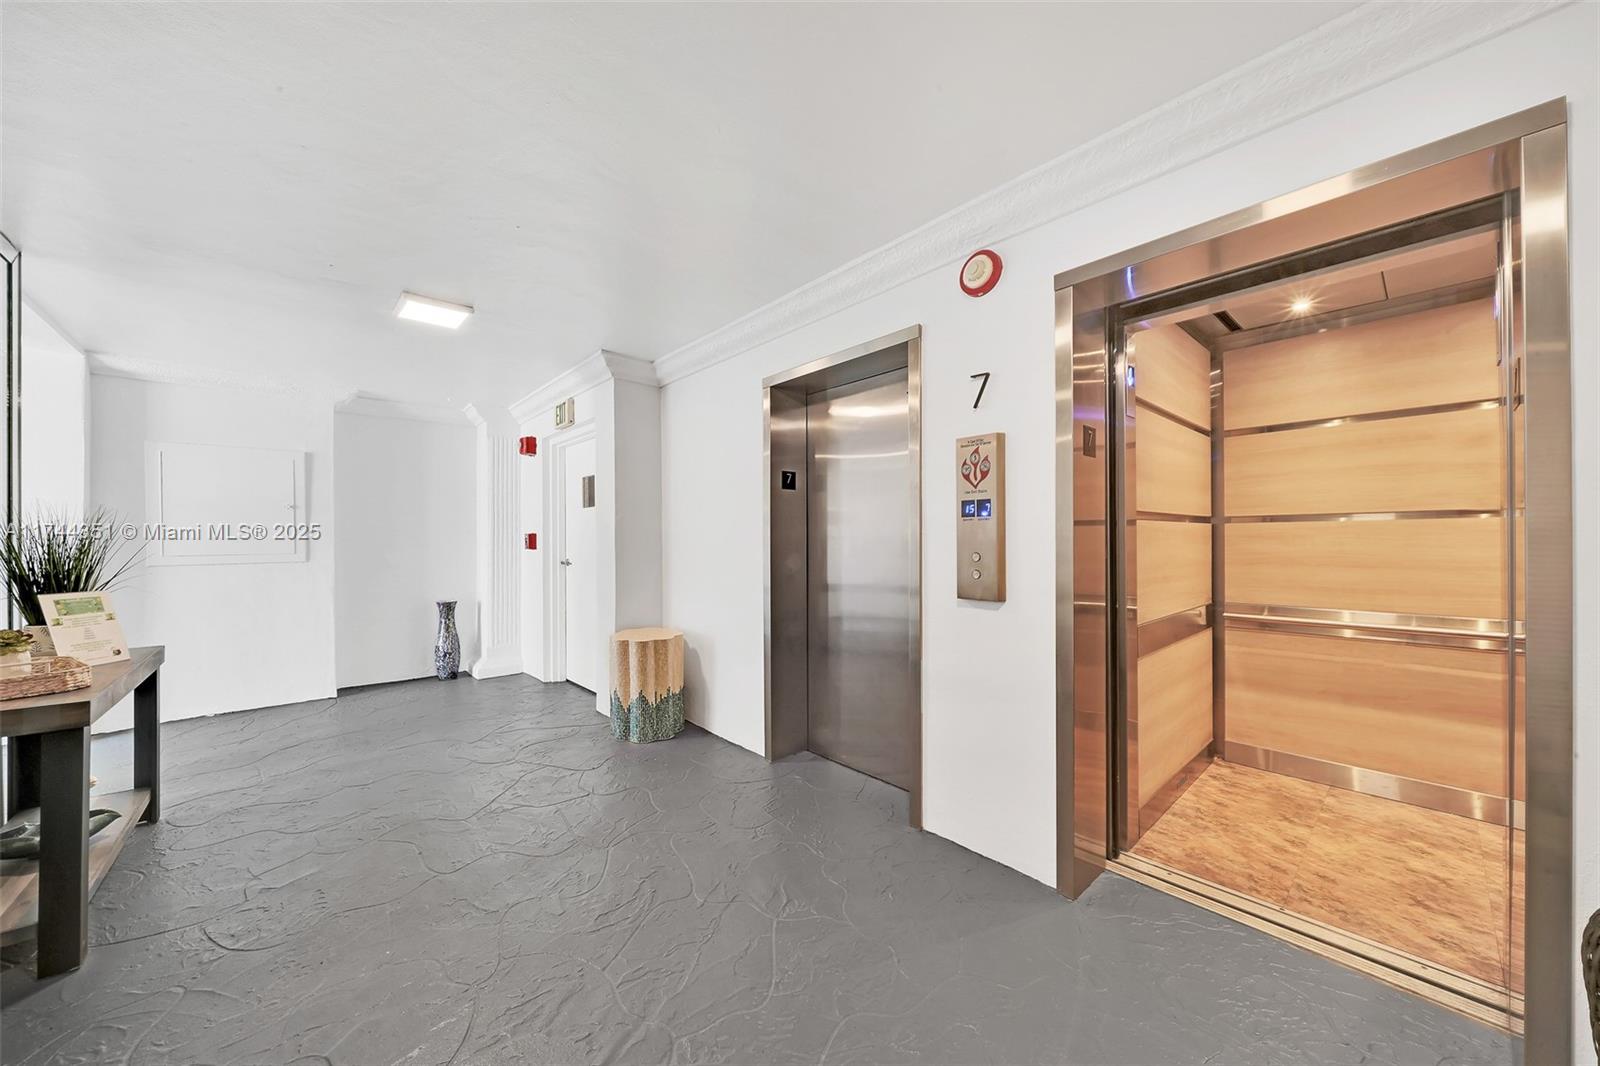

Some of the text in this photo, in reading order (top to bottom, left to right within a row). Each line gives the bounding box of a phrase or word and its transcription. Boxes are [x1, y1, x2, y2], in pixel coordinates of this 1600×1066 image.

[970, 372, 990, 409] 7
[555, 402, 566, 426] EXIT
[786, 473, 792, 484] 7
[965, 504, 975, 514] 15
